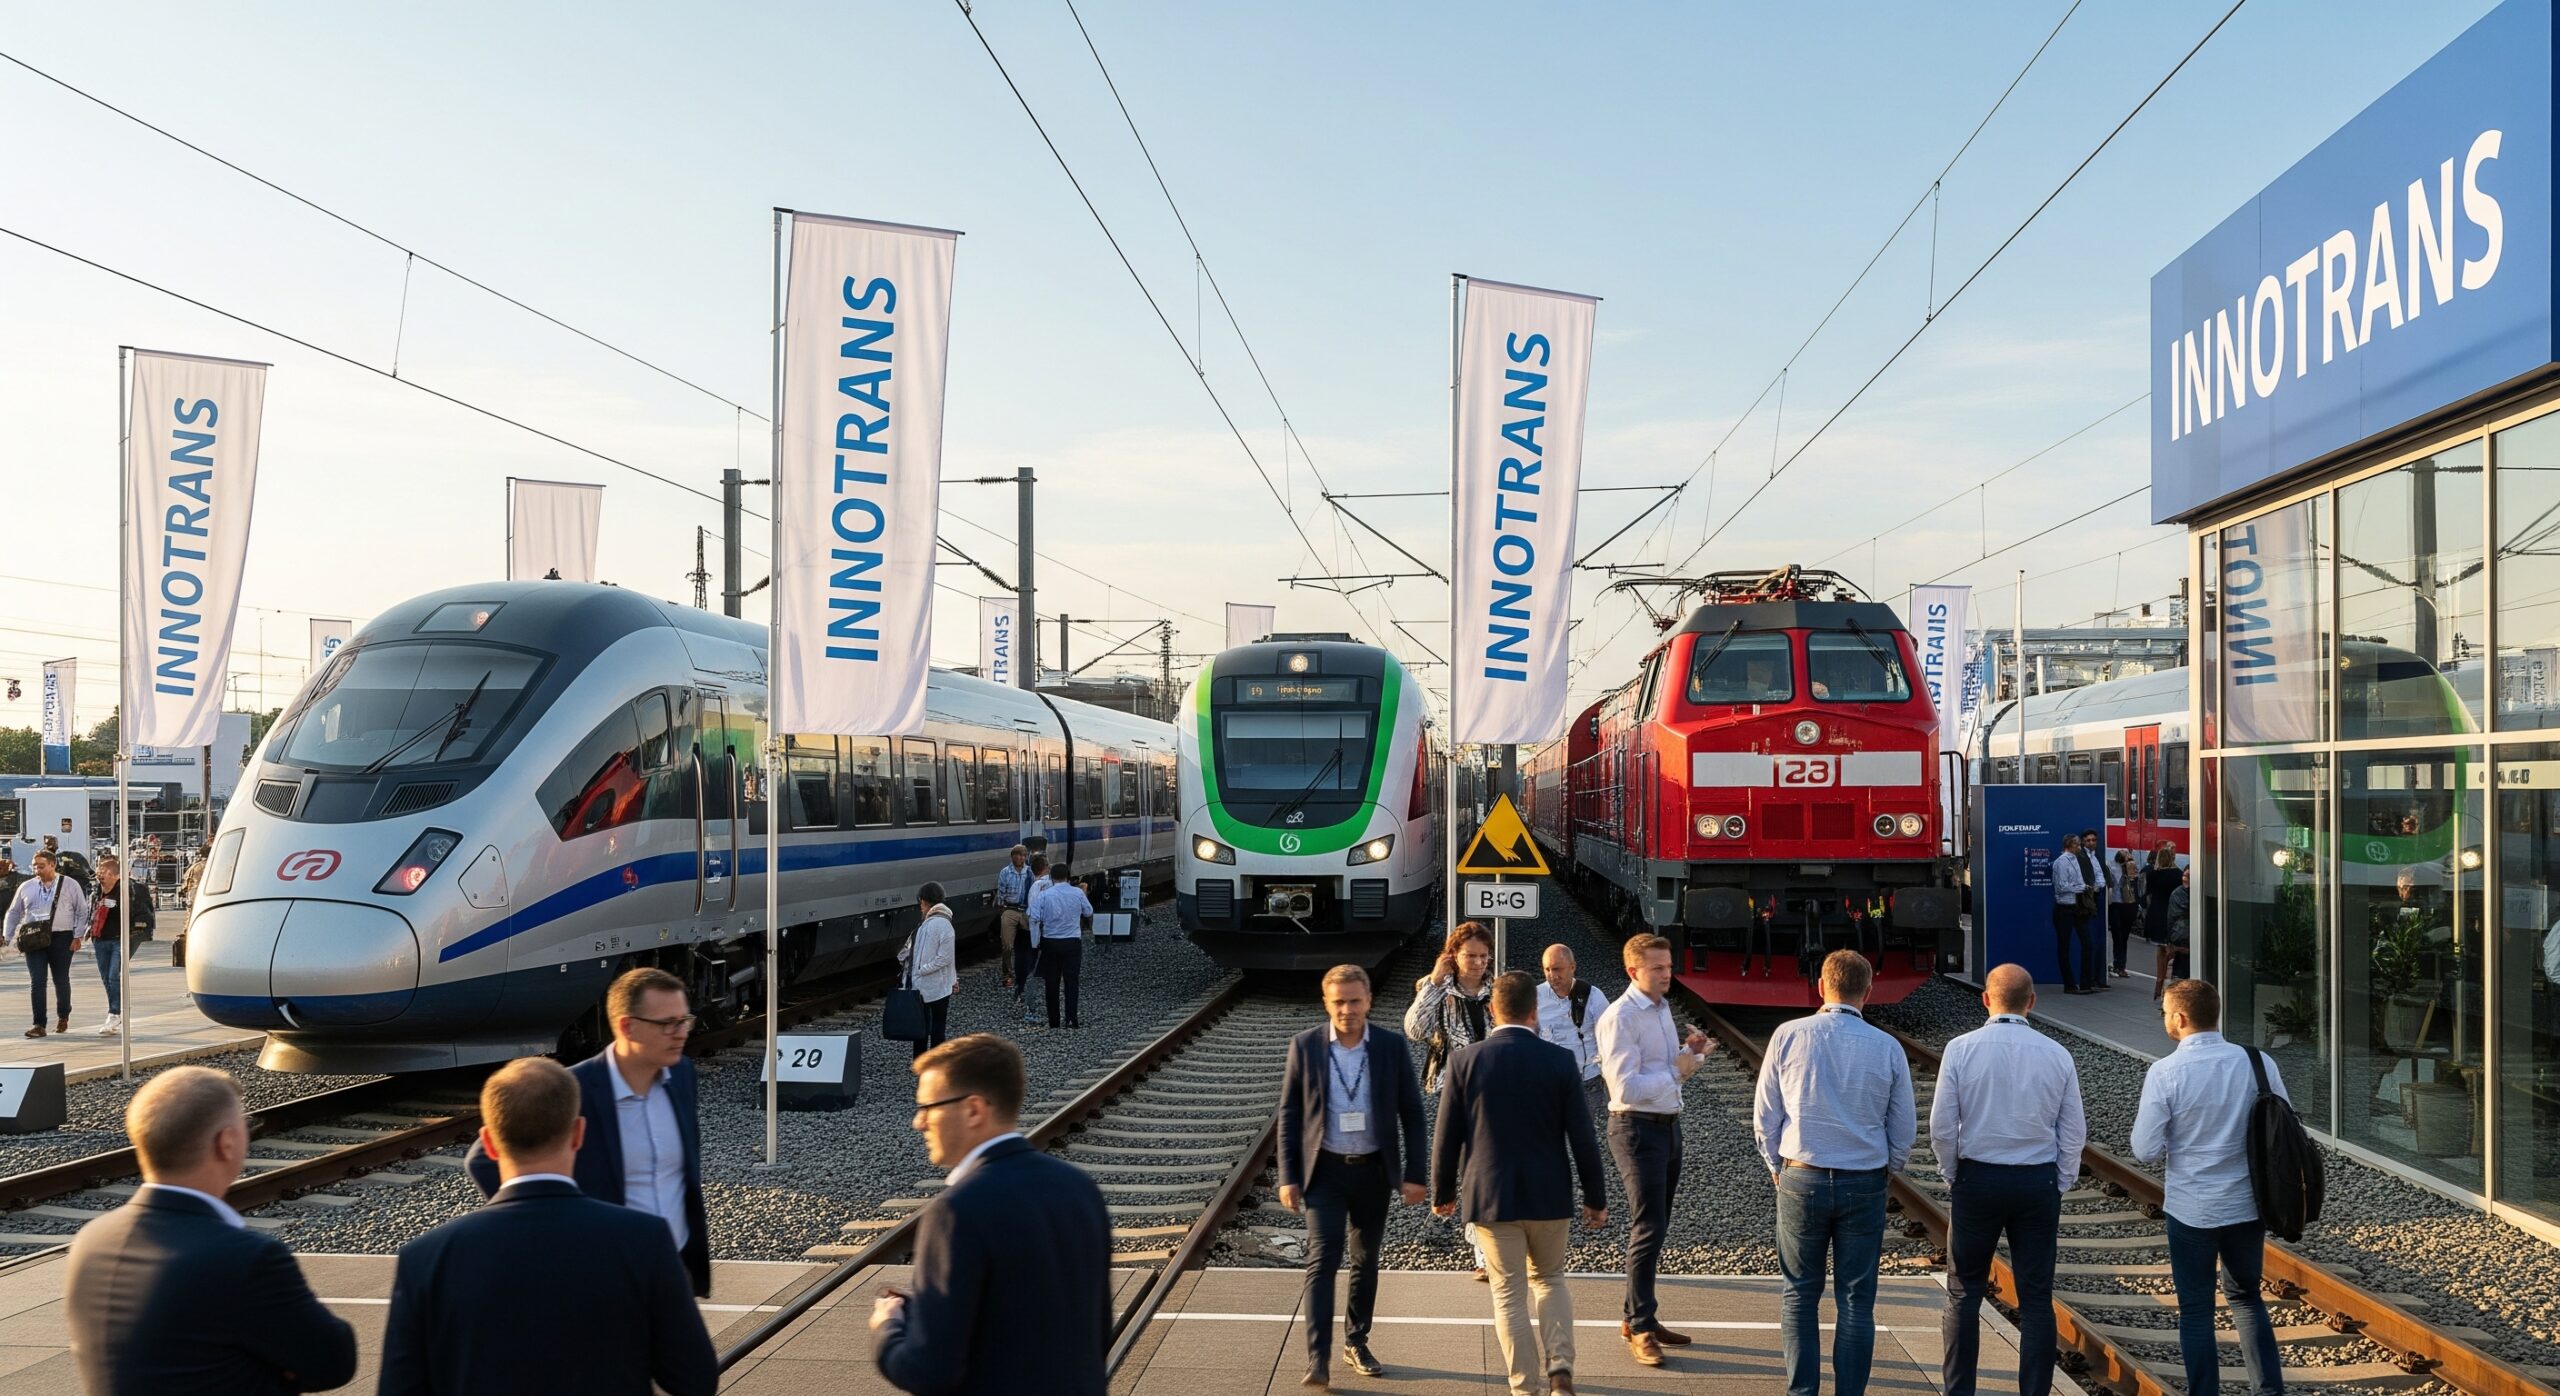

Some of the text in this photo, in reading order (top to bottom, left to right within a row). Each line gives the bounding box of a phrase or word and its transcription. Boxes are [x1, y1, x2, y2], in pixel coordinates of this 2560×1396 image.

[2171, 129, 2504, 443] INNOTRANS
[155, 397, 219, 697] INNOTRANS
[825, 275, 898, 662] INNOTRANS
[1484, 331, 1551, 682] INNOTRANS
[791, 1048, 823, 1069] 20
